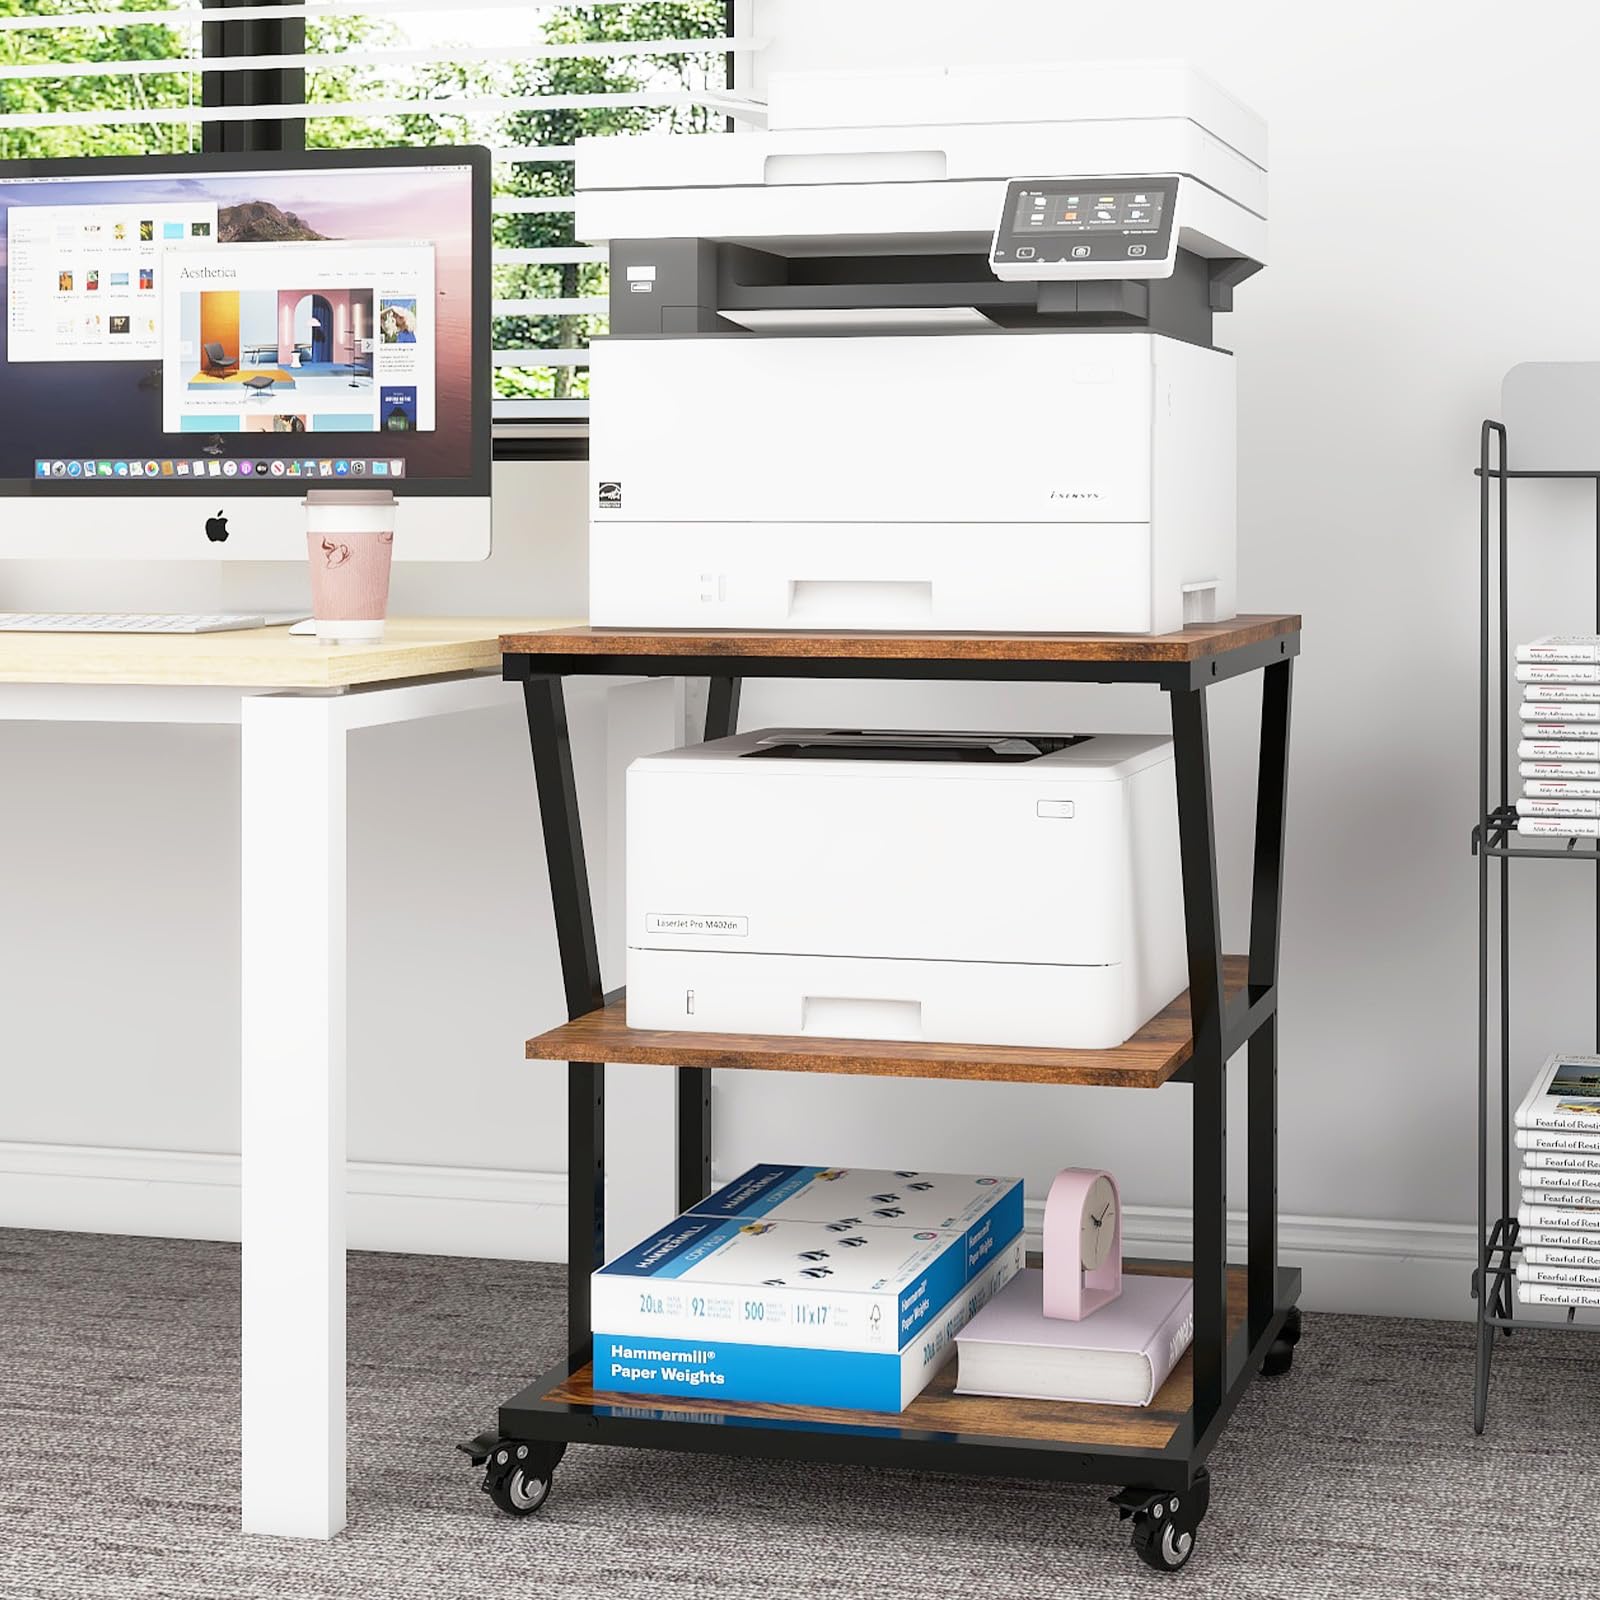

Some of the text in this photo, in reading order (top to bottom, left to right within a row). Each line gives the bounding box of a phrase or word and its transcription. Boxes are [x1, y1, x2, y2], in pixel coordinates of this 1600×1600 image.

[180, 266, 237, 279] Aesthetica
[657, 919, 688, 928] LaserJet
[690, 919, 703, 929] Pro
[1536, 1118, 1566, 1127] Fearful
[1567, 1120, 1576, 1128] of
[1536, 1138, 1567, 1148] Fearful
[1568, 1140, 1577, 1149] of
[1545, 1157, 1576, 1167] Fearful
[1577, 1159, 1586, 1168] of
[1540, 1176, 1571, 1186] Fearful
[1572, 1178, 1581, 1187] of
[721, 1170, 785, 1210] HAMMERMILL
[1544, 1194, 1573, 1203] Fearful
[1575, 1195, 1584, 1204] of
[1540, 1217, 1570, 1226] Fearful
[1571, 1218, 1581, 1227] of
[1540, 1234, 1571, 1244] Fearful
[1572, 1236, 1581, 1245] of
[635, 1223, 707, 1269] HAMMERMILL
[1545, 1254, 1576, 1263] Fearful
[1577, 1255, 1586, 1264] of
[1537, 1272, 1568, 1281] Fearful
[1569, 1273, 1578, 1282] of
[1540, 1293, 1570, 1303] Fearful
[1571, 1295, 1581, 1303] of
[691, 1297, 705, 1316] 92
[745, 1301, 765, 1321] 500
[611, 1363, 725, 1385] Paper Weights
